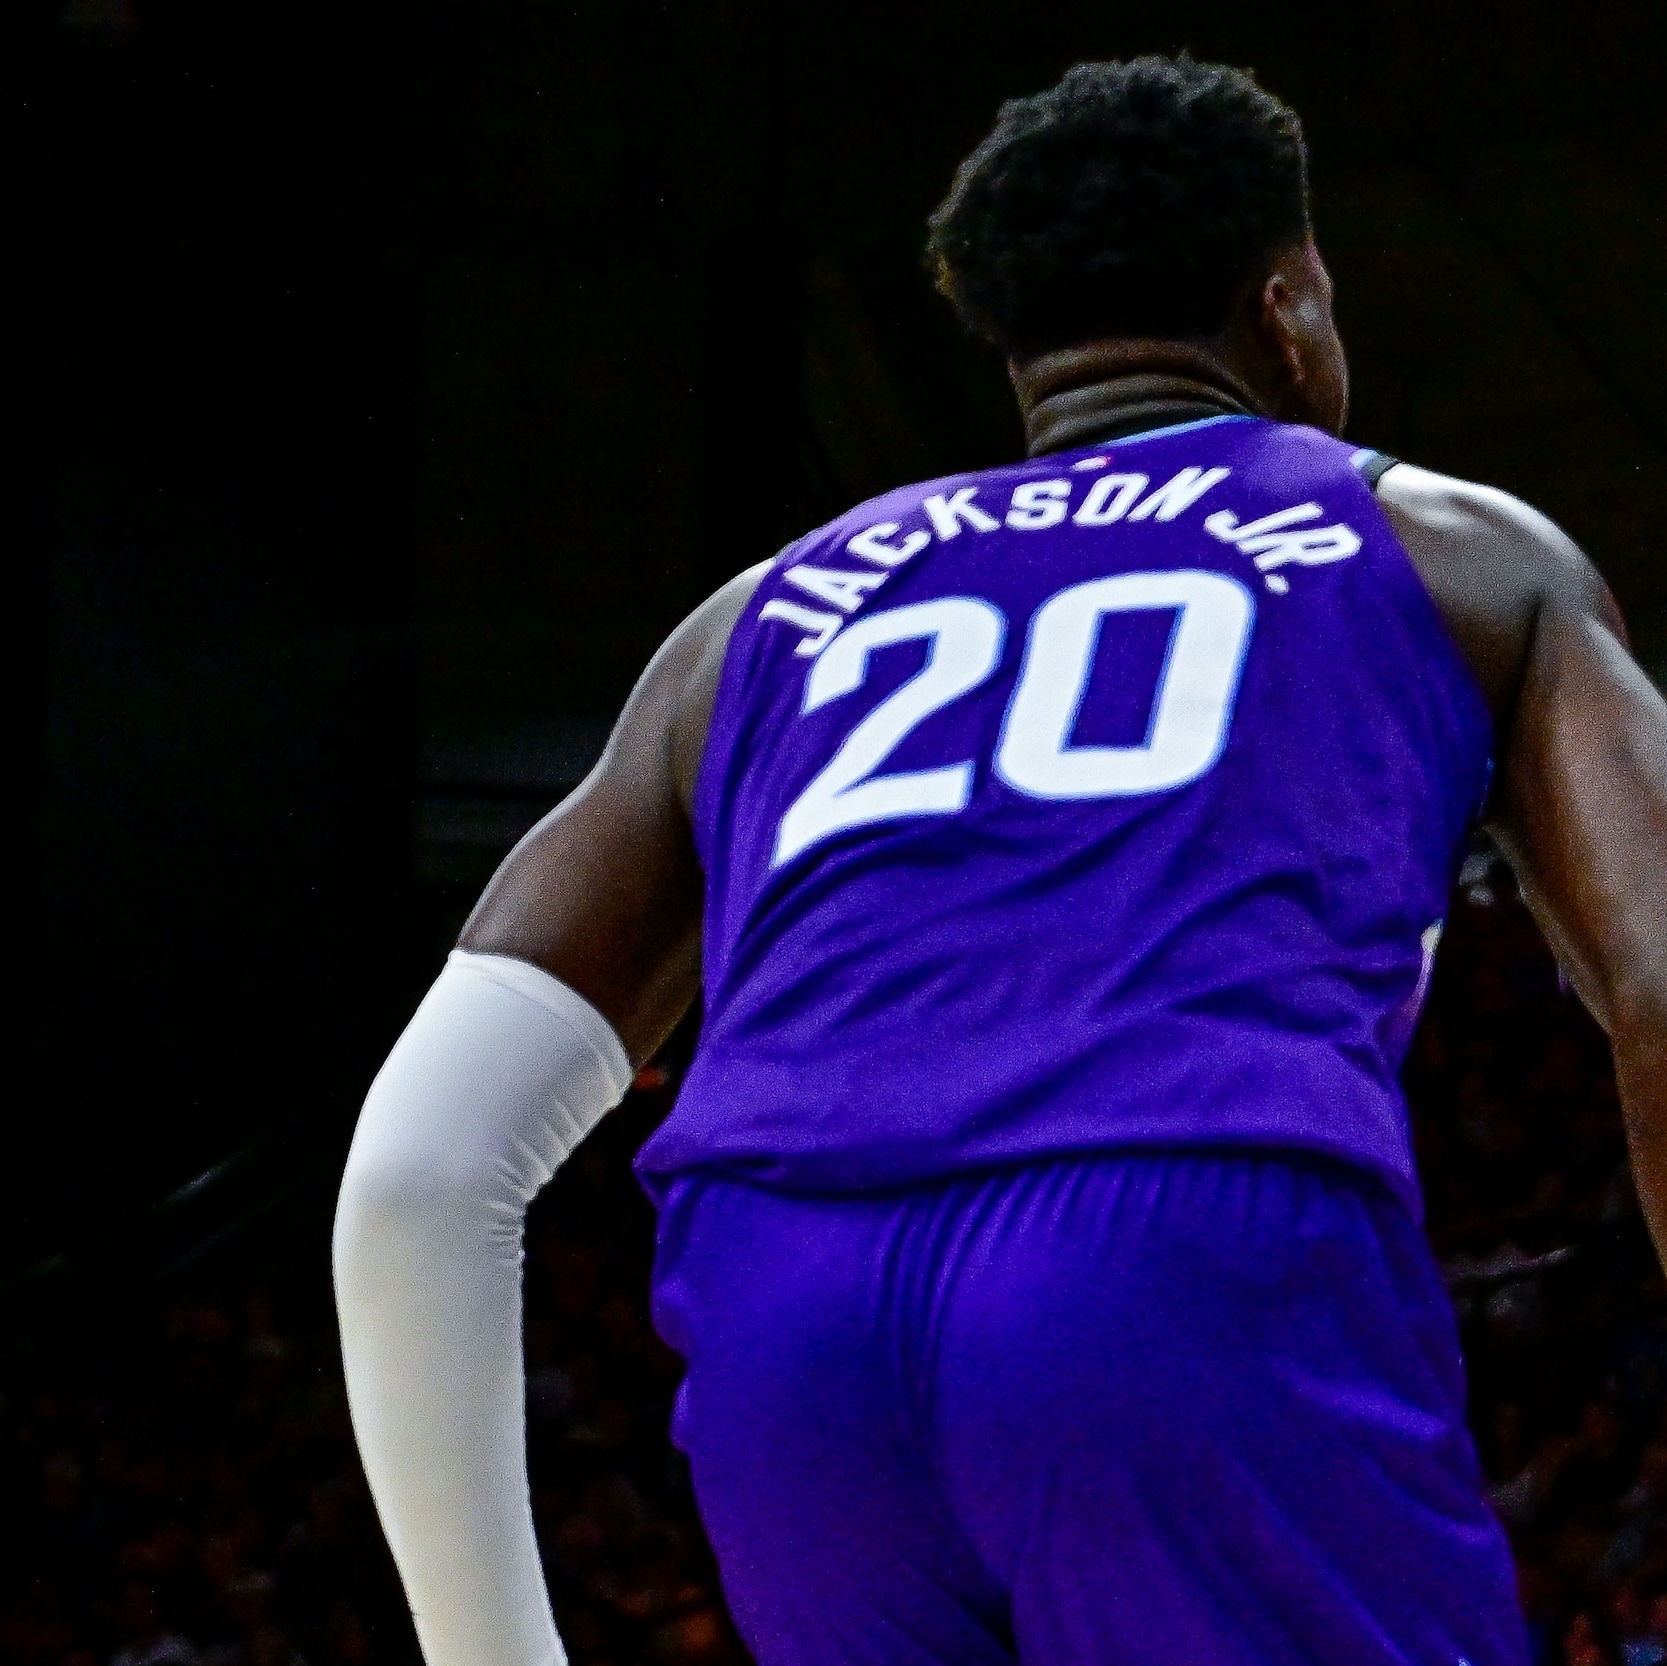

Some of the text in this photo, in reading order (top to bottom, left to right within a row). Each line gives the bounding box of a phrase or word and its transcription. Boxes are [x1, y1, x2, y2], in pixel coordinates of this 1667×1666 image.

[757, 464, 1363, 659] JACKSON JR.
[770, 567, 1256, 869] 20
